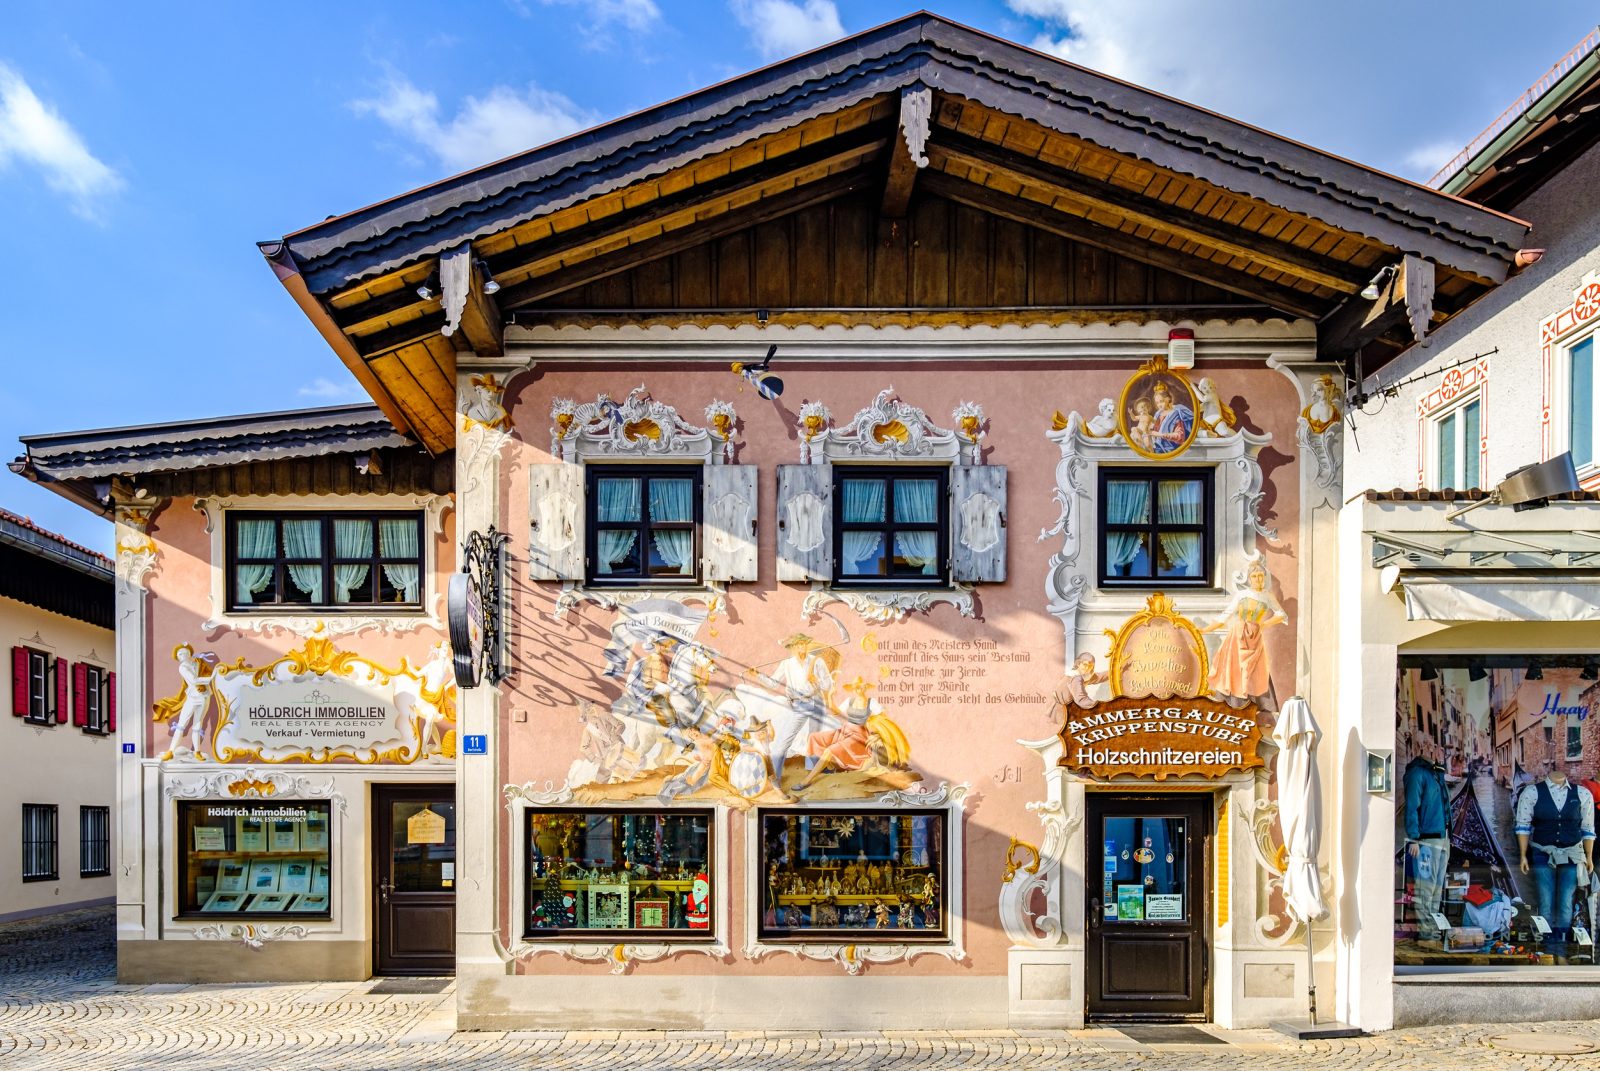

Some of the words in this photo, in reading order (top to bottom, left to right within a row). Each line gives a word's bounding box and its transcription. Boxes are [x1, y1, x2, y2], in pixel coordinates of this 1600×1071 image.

[893, 639, 909, 650] und
[912, 640, 927, 650] des
[929, 639, 971, 650] Meisters
[973, 639, 998, 651] Hand
[920, 651, 939, 662] dies
[941, 652, 965, 664] Haus
[991, 651, 1031, 662] Bestand
[939, 669, 955, 678] zur
[957, 665, 986, 679] Zierde
[878, 680, 897, 691] dem
[899, 681, 915, 691] Ort
[919, 683, 933, 693] zur
[937, 680, 970, 692] Würde
[878, 696, 895, 704] uns
[899, 695, 915, 707] zur
[917, 693, 952, 706] Freude
[957, 693, 981, 706] steht
[985, 693, 1002, 704] das
[1004, 693, 1047, 704] Gebäude
[1530, 692, 1589, 721] Haag
[249, 704, 311, 718] HÖLDRICH
[315, 706, 385, 718] IMMOBILIEN
[1068, 706, 1256, 734] AMMERGAUER
[266, 729, 302, 738] Verkauf
[311, 729, 366, 739] Vermietung
[1074, 721, 1248, 746] KRIPPENSTUBE
[470, 736, 479, 748] 11
[1076, 747, 1243, 765] Holzschnitzereien
[208, 807, 249, 817] Höldrich
[251, 807, 307, 817] Immobilien
